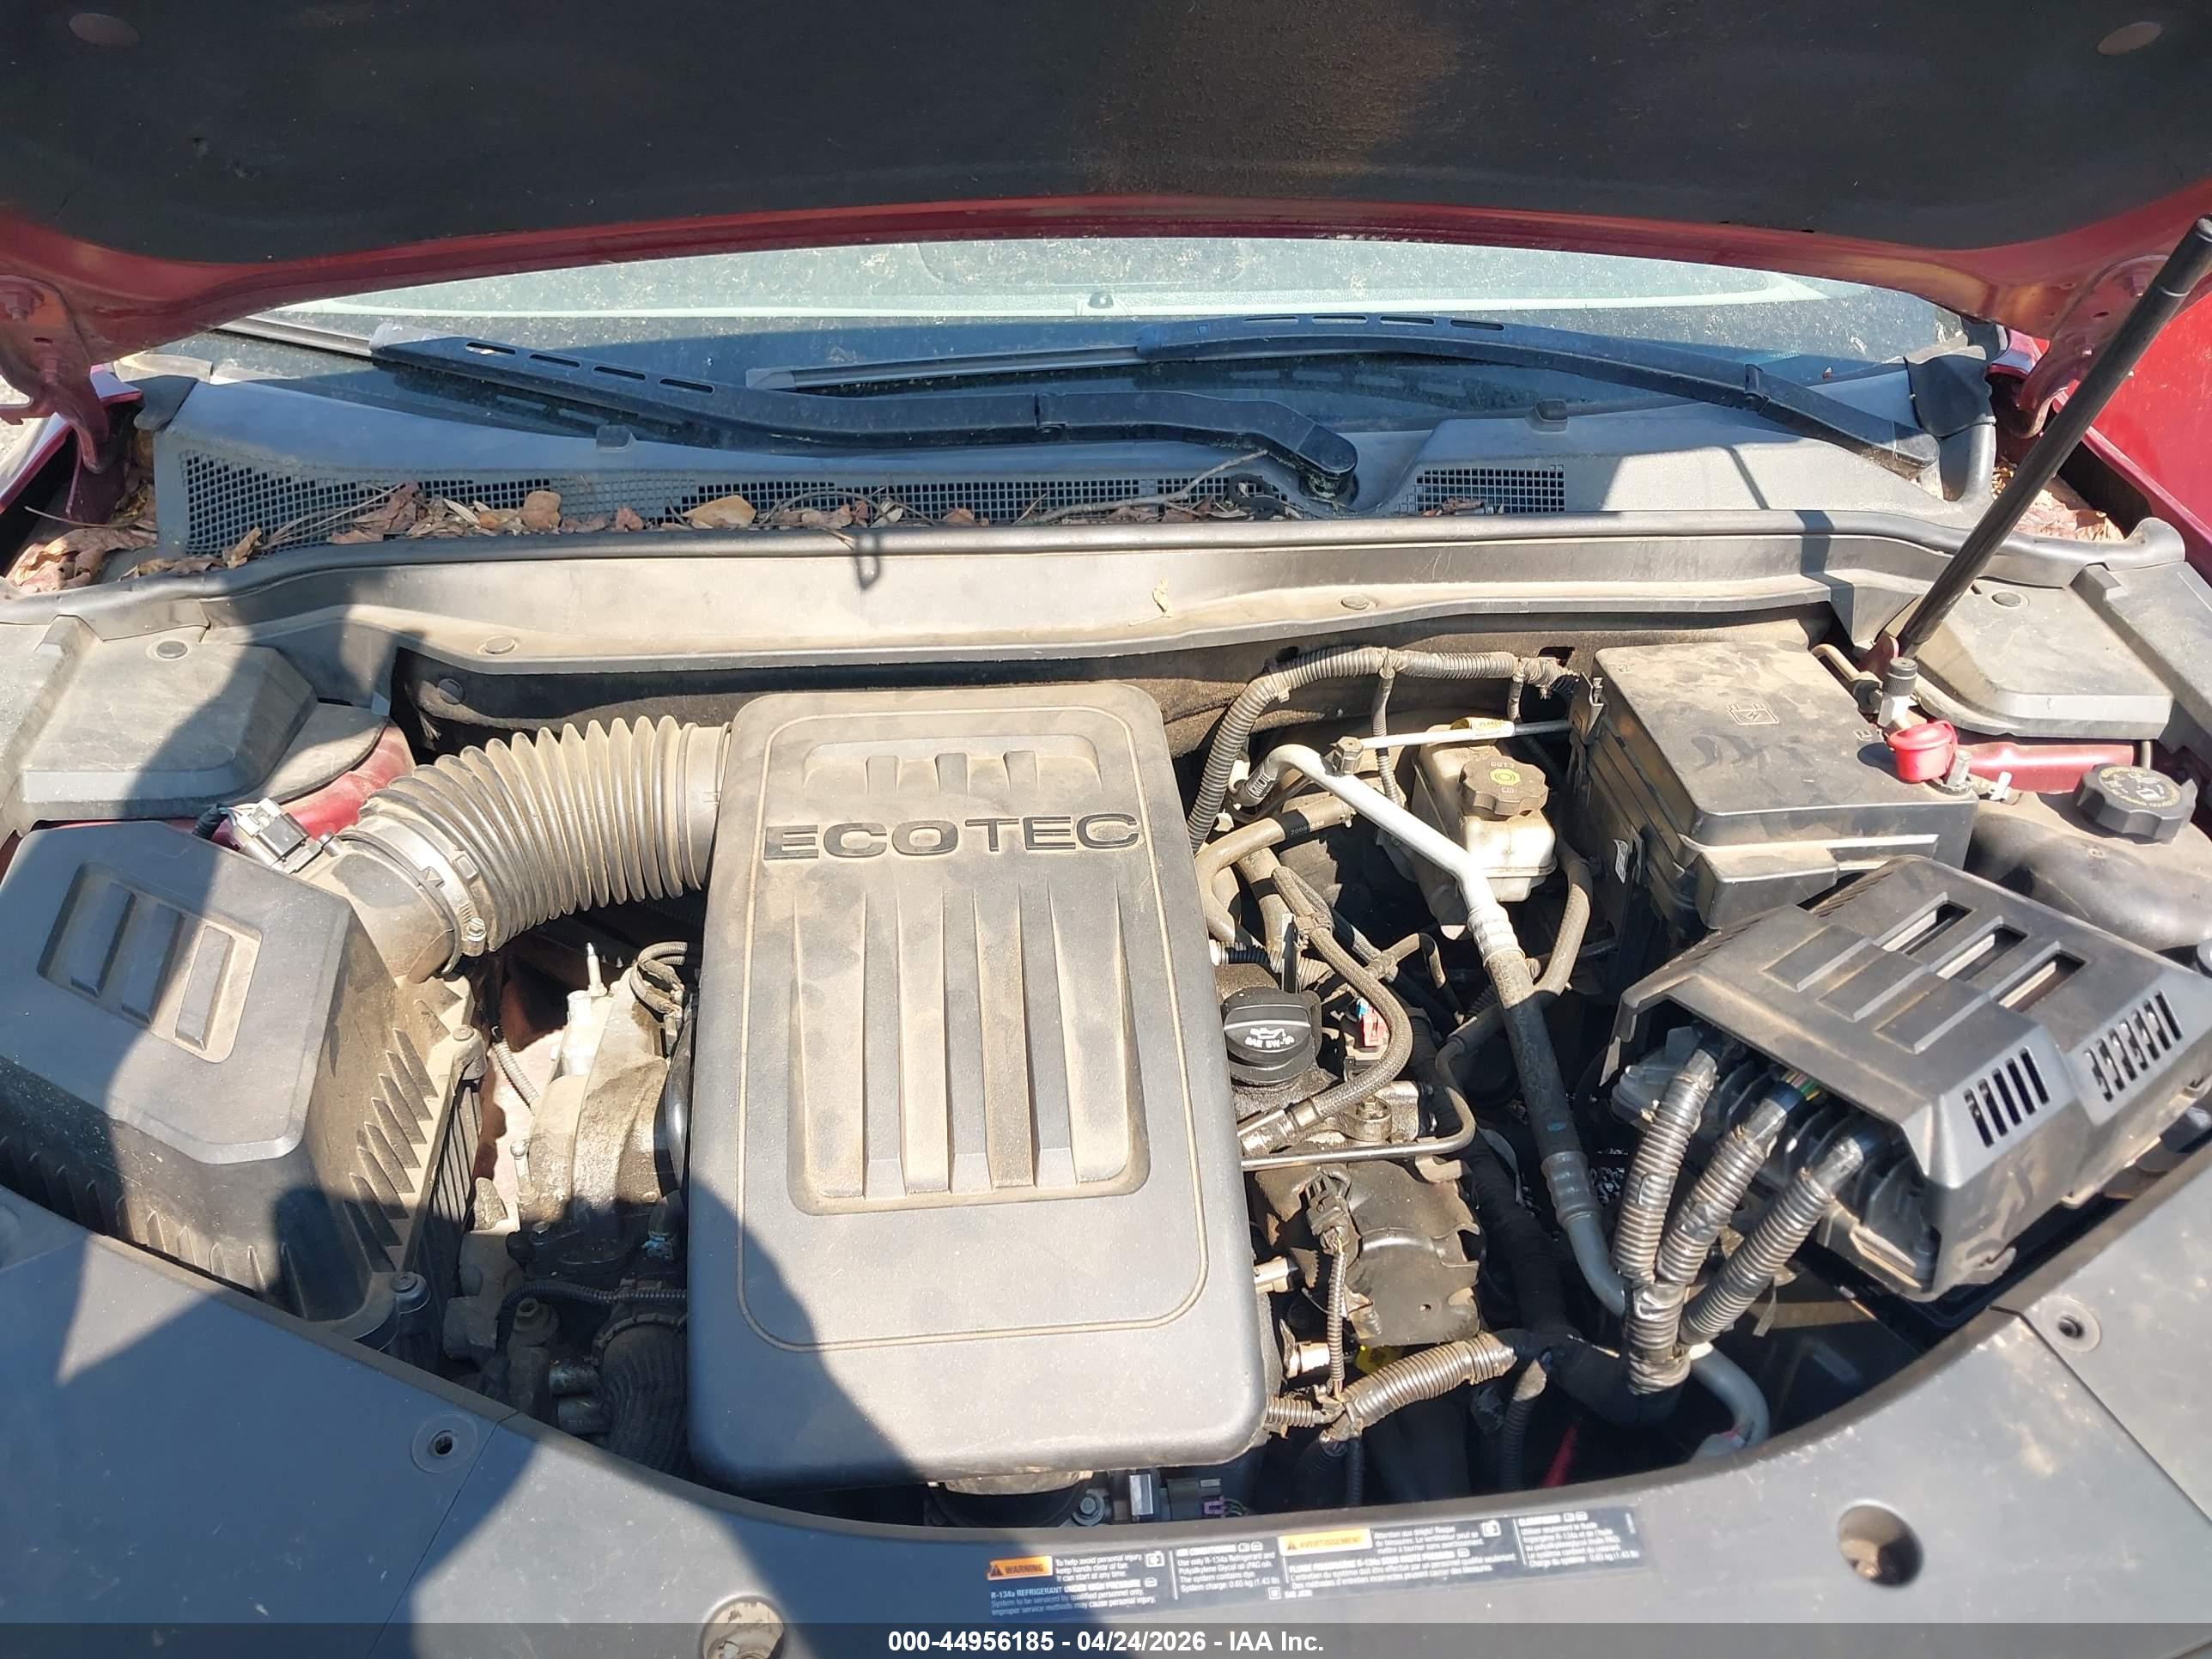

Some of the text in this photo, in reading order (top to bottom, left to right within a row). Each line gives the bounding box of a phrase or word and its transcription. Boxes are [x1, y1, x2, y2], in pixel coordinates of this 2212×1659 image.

[763, 813, 1139, 860] ECOTEC
[1300, 1536, 1361, 1547] AVERTISSEMENT
[1055, 1559, 1064, 1567] To
[1064, 1558, 1079, 1567] help
[1079, 1556, 1096, 1565] avoid
[1097, 1554, 1123, 1565] personal
[1005, 1564, 1043, 1575] WARNING
[1099, 1571, 1110, 1580] any
[1017, 1586, 1062, 1596] REFRIGERANT
[1071, 1592, 1097, 1601] qualified
[1098, 1589, 1128, 1599] personnel
[992, 1607, 1020, 1616] Improper
[1109, 1597, 1135, 1607] personal
